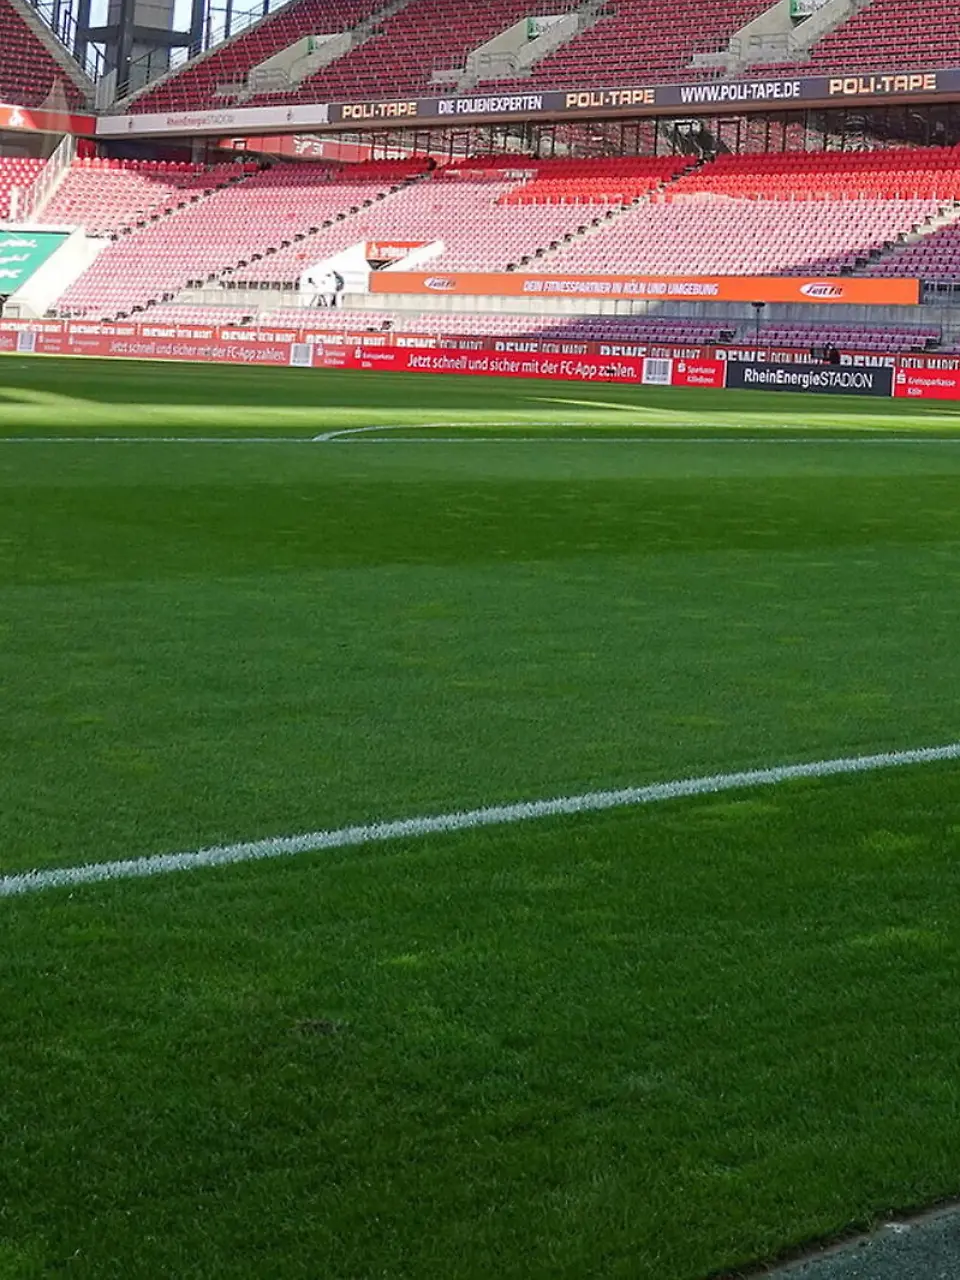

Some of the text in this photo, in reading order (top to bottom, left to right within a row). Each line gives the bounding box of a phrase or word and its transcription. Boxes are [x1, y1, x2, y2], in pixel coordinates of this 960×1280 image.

[681, 81, 800, 102] WWW.POLI-TAPE.DE
[829, 74, 936, 94] POLI-TAPE
[438, 95, 543, 114] DIE FOLIENEXPERTEN
[566, 89, 655, 107] POLI-TAPE
[342, 102, 417, 118] POLI-TAPE
[408, 354, 430, 368] Jetzt
[432, 356, 467, 370] schnell
[469, 358, 488, 371] und
[490, 358, 520, 372] sicher
[522, 360, 539, 373] mit
[541, 360, 558, 375] der
[560, 361, 596, 379] FC-App
[744, 368, 873, 388] RheinEnergieSTADION
